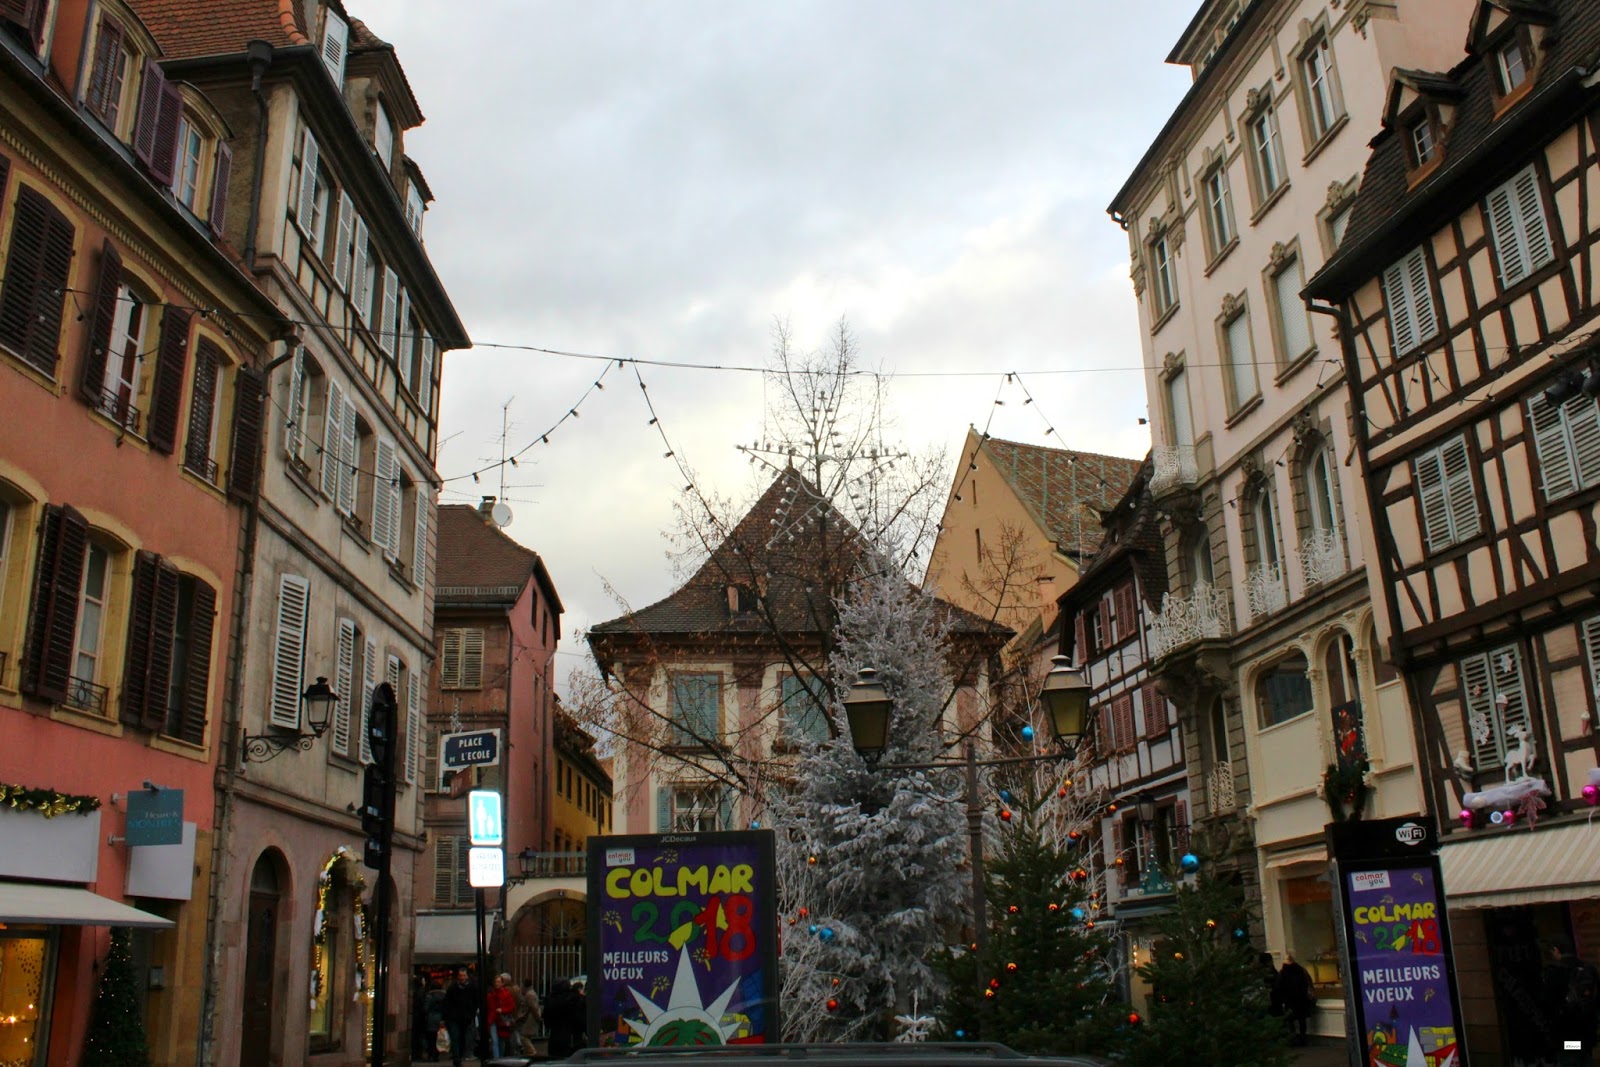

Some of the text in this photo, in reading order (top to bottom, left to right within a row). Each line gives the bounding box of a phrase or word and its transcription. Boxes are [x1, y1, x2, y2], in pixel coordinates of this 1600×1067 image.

[458, 737, 483, 748] PLACE
[461, 750, 491, 761] L'ECOLE
[660, 835, 697, 843] JCDecaux
[605, 863, 754, 899] COLMAR
[1355, 872, 1384, 881] colmar
[1368, 878, 1384, 886] you
[1354, 902, 1436, 925] COLMAR
[631, 894, 756, 962] 2018
[1372, 919, 1441, 956] 2018
[603, 951, 669, 965] MEILLEURS
[603, 967, 644, 980] VOEUX
[1363, 965, 1441, 985] MEILLEURS
[1365, 986, 1414, 1003] VOEUX
